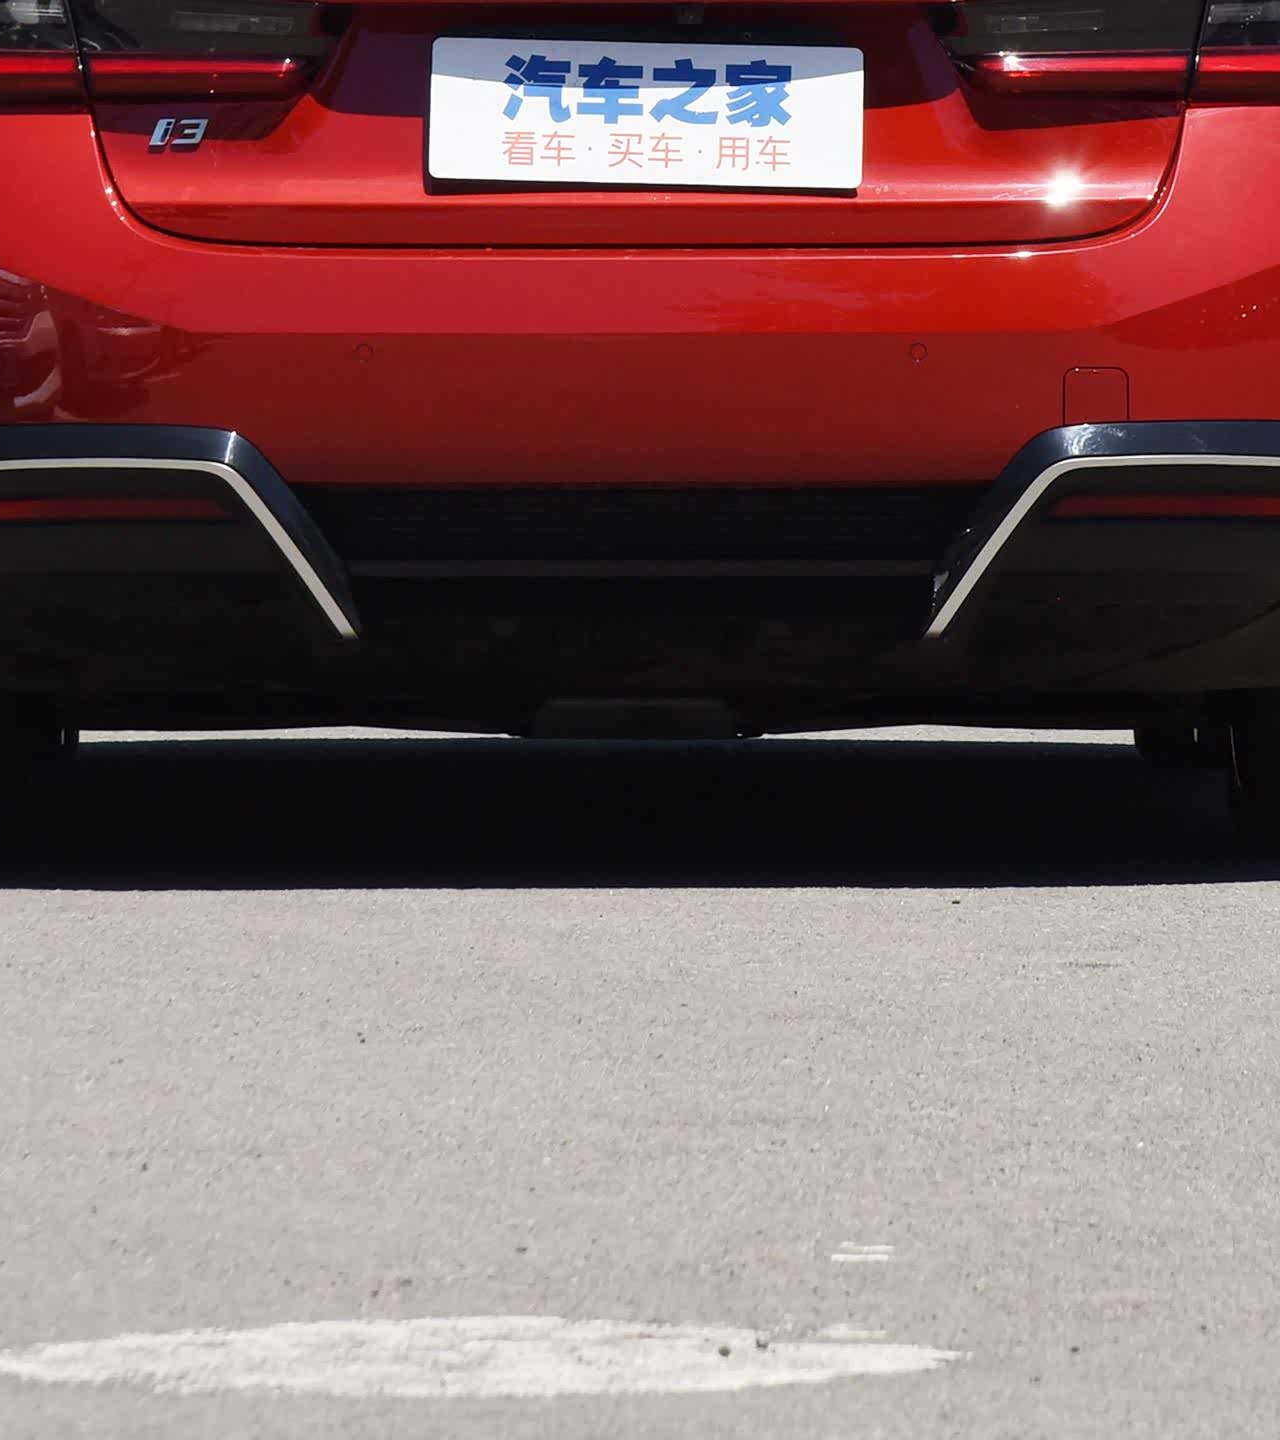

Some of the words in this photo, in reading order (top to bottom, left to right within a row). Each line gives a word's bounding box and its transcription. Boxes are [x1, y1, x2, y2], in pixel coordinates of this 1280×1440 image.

[502, 54, 793, 128] 汽车之家
[149, 118, 209, 146] i3
